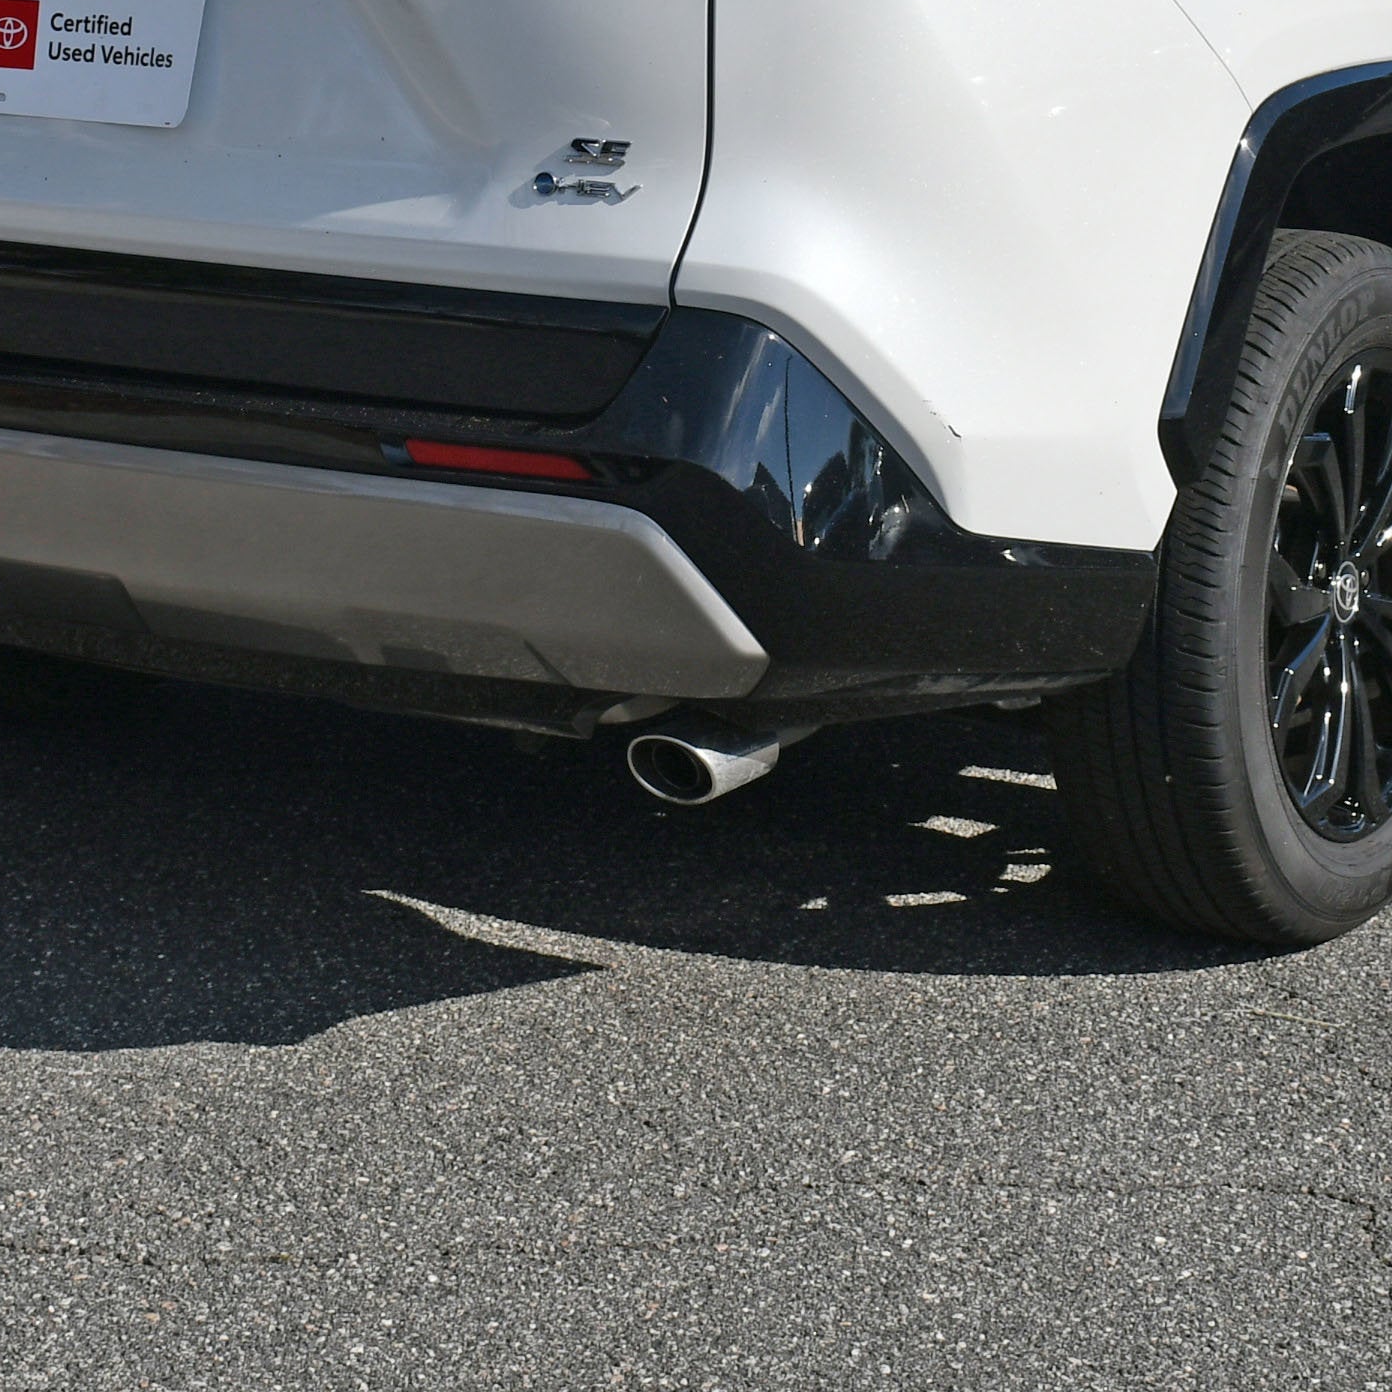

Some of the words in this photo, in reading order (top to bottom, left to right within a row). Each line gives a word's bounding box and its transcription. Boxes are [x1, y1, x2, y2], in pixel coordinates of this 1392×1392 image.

[50, 12, 133, 36] Certified
[48, 41, 95, 64] Used
[101, 45, 173, 69] Vehicles
[1279, 287, 1376, 445] DUNLOP
